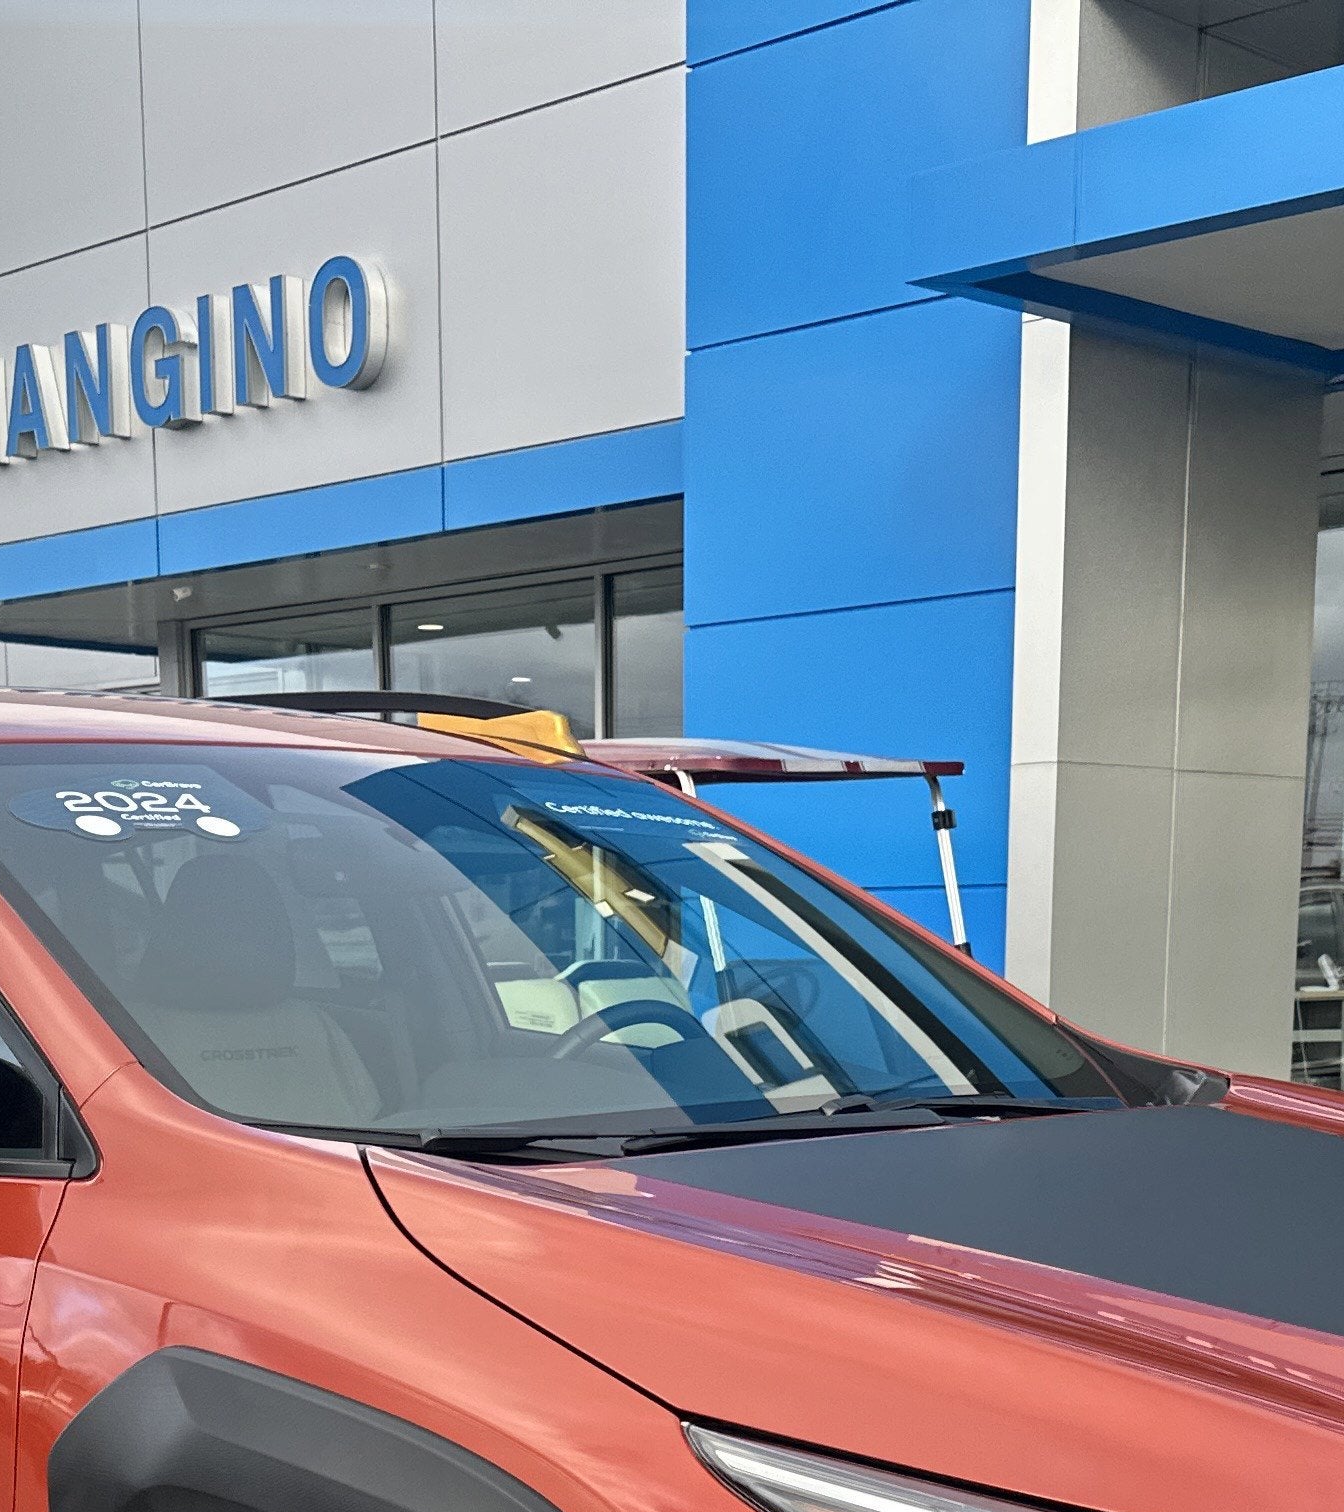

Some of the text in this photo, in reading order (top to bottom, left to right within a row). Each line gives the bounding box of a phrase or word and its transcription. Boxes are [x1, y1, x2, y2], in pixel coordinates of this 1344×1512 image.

[56, 791, 211, 813] 2024
[544, 801, 633, 819] Certified
[120, 813, 182, 821] Certified
